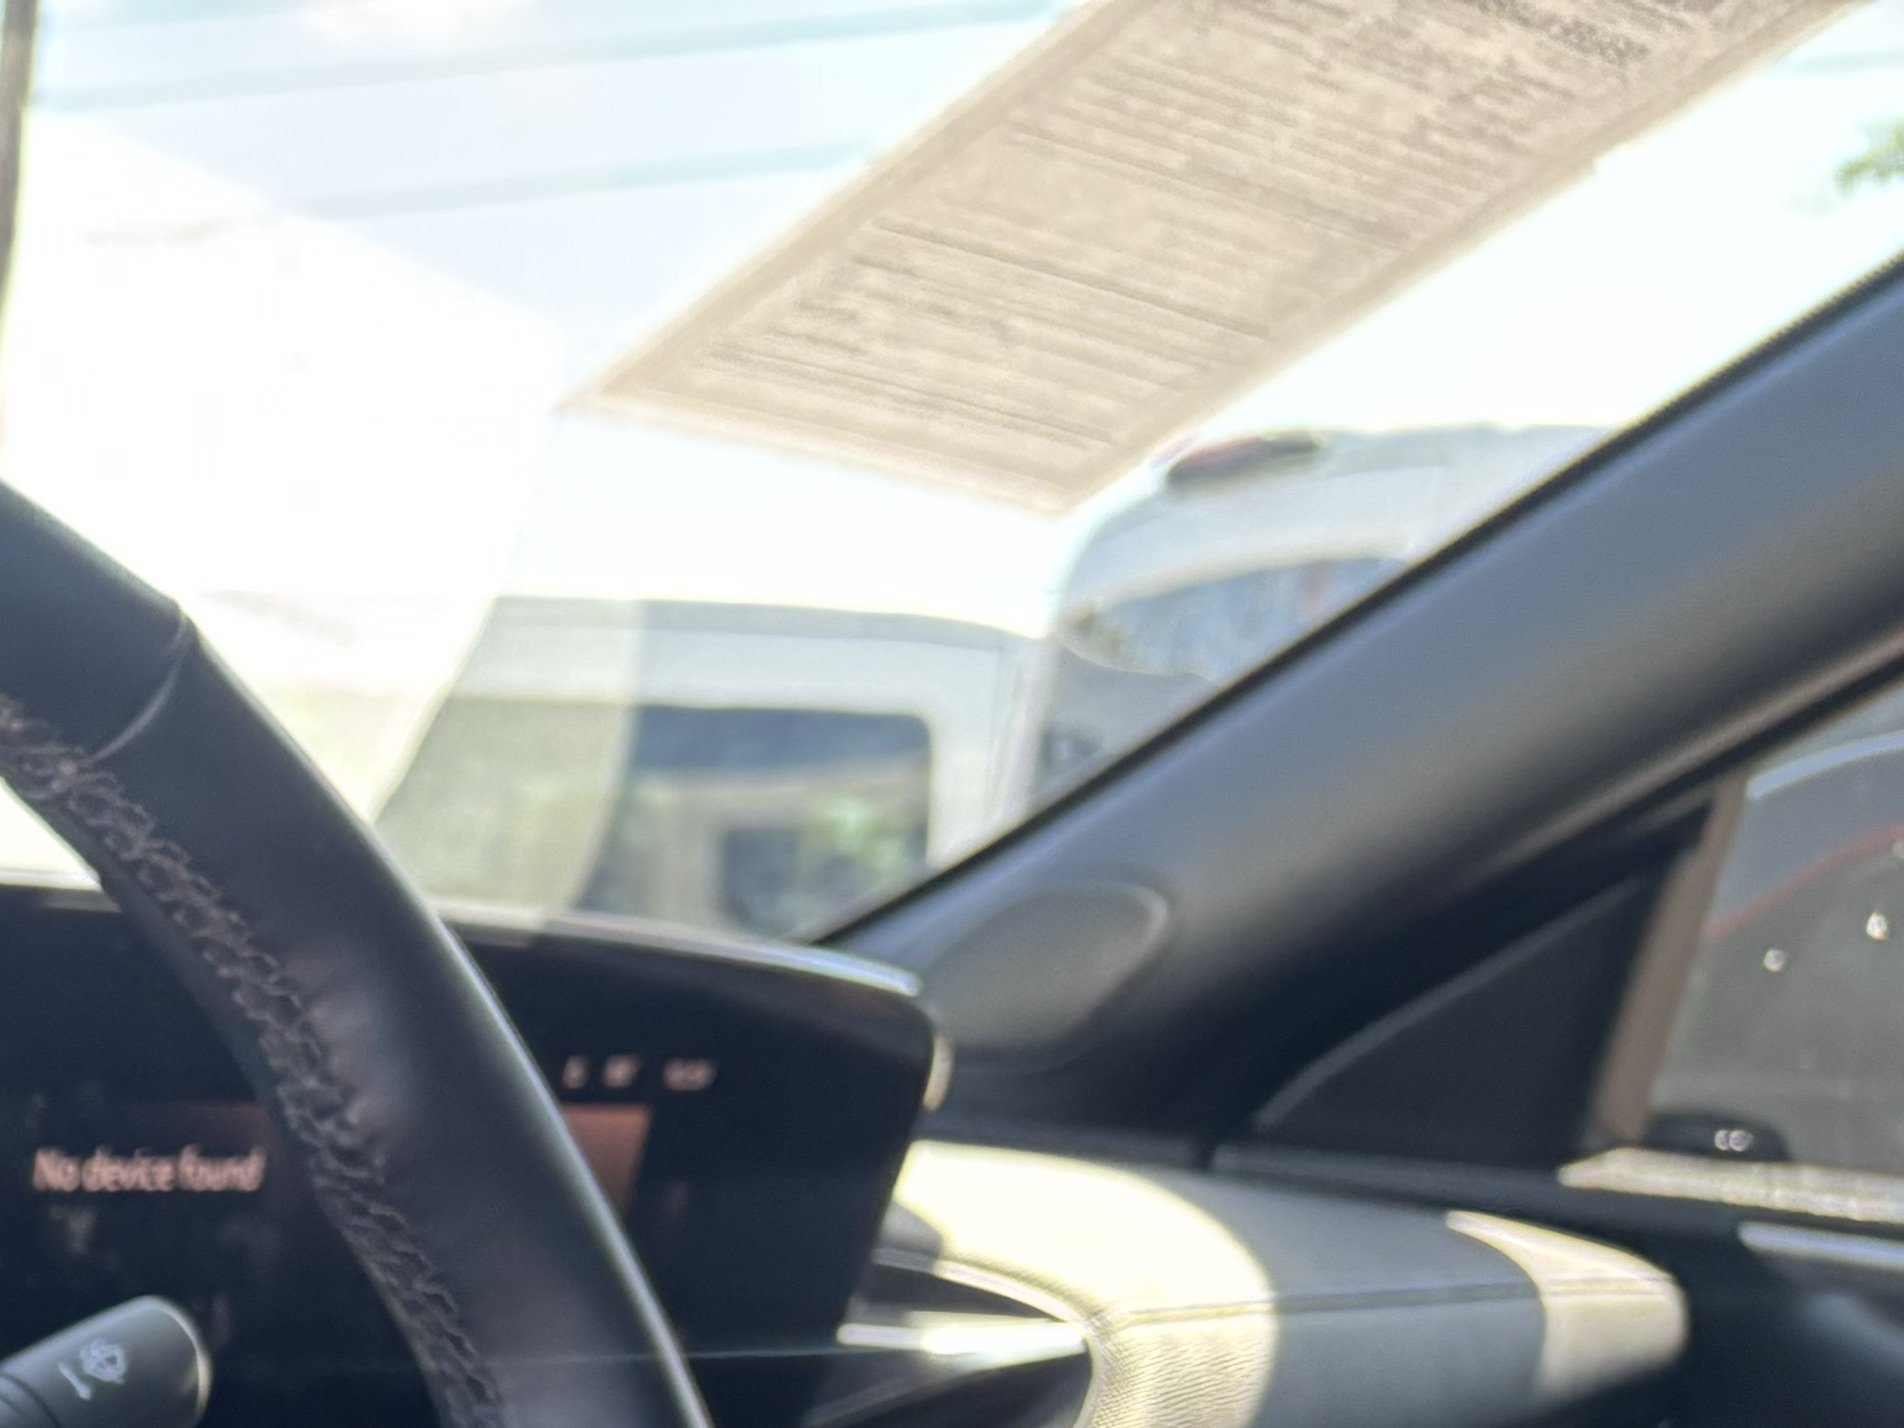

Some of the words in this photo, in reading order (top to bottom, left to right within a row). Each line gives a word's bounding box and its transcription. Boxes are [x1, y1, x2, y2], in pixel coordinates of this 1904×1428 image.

[33, 1146, 81, 1193] No
[82, 1145, 176, 1193] device
[179, 1143, 268, 1193] found
